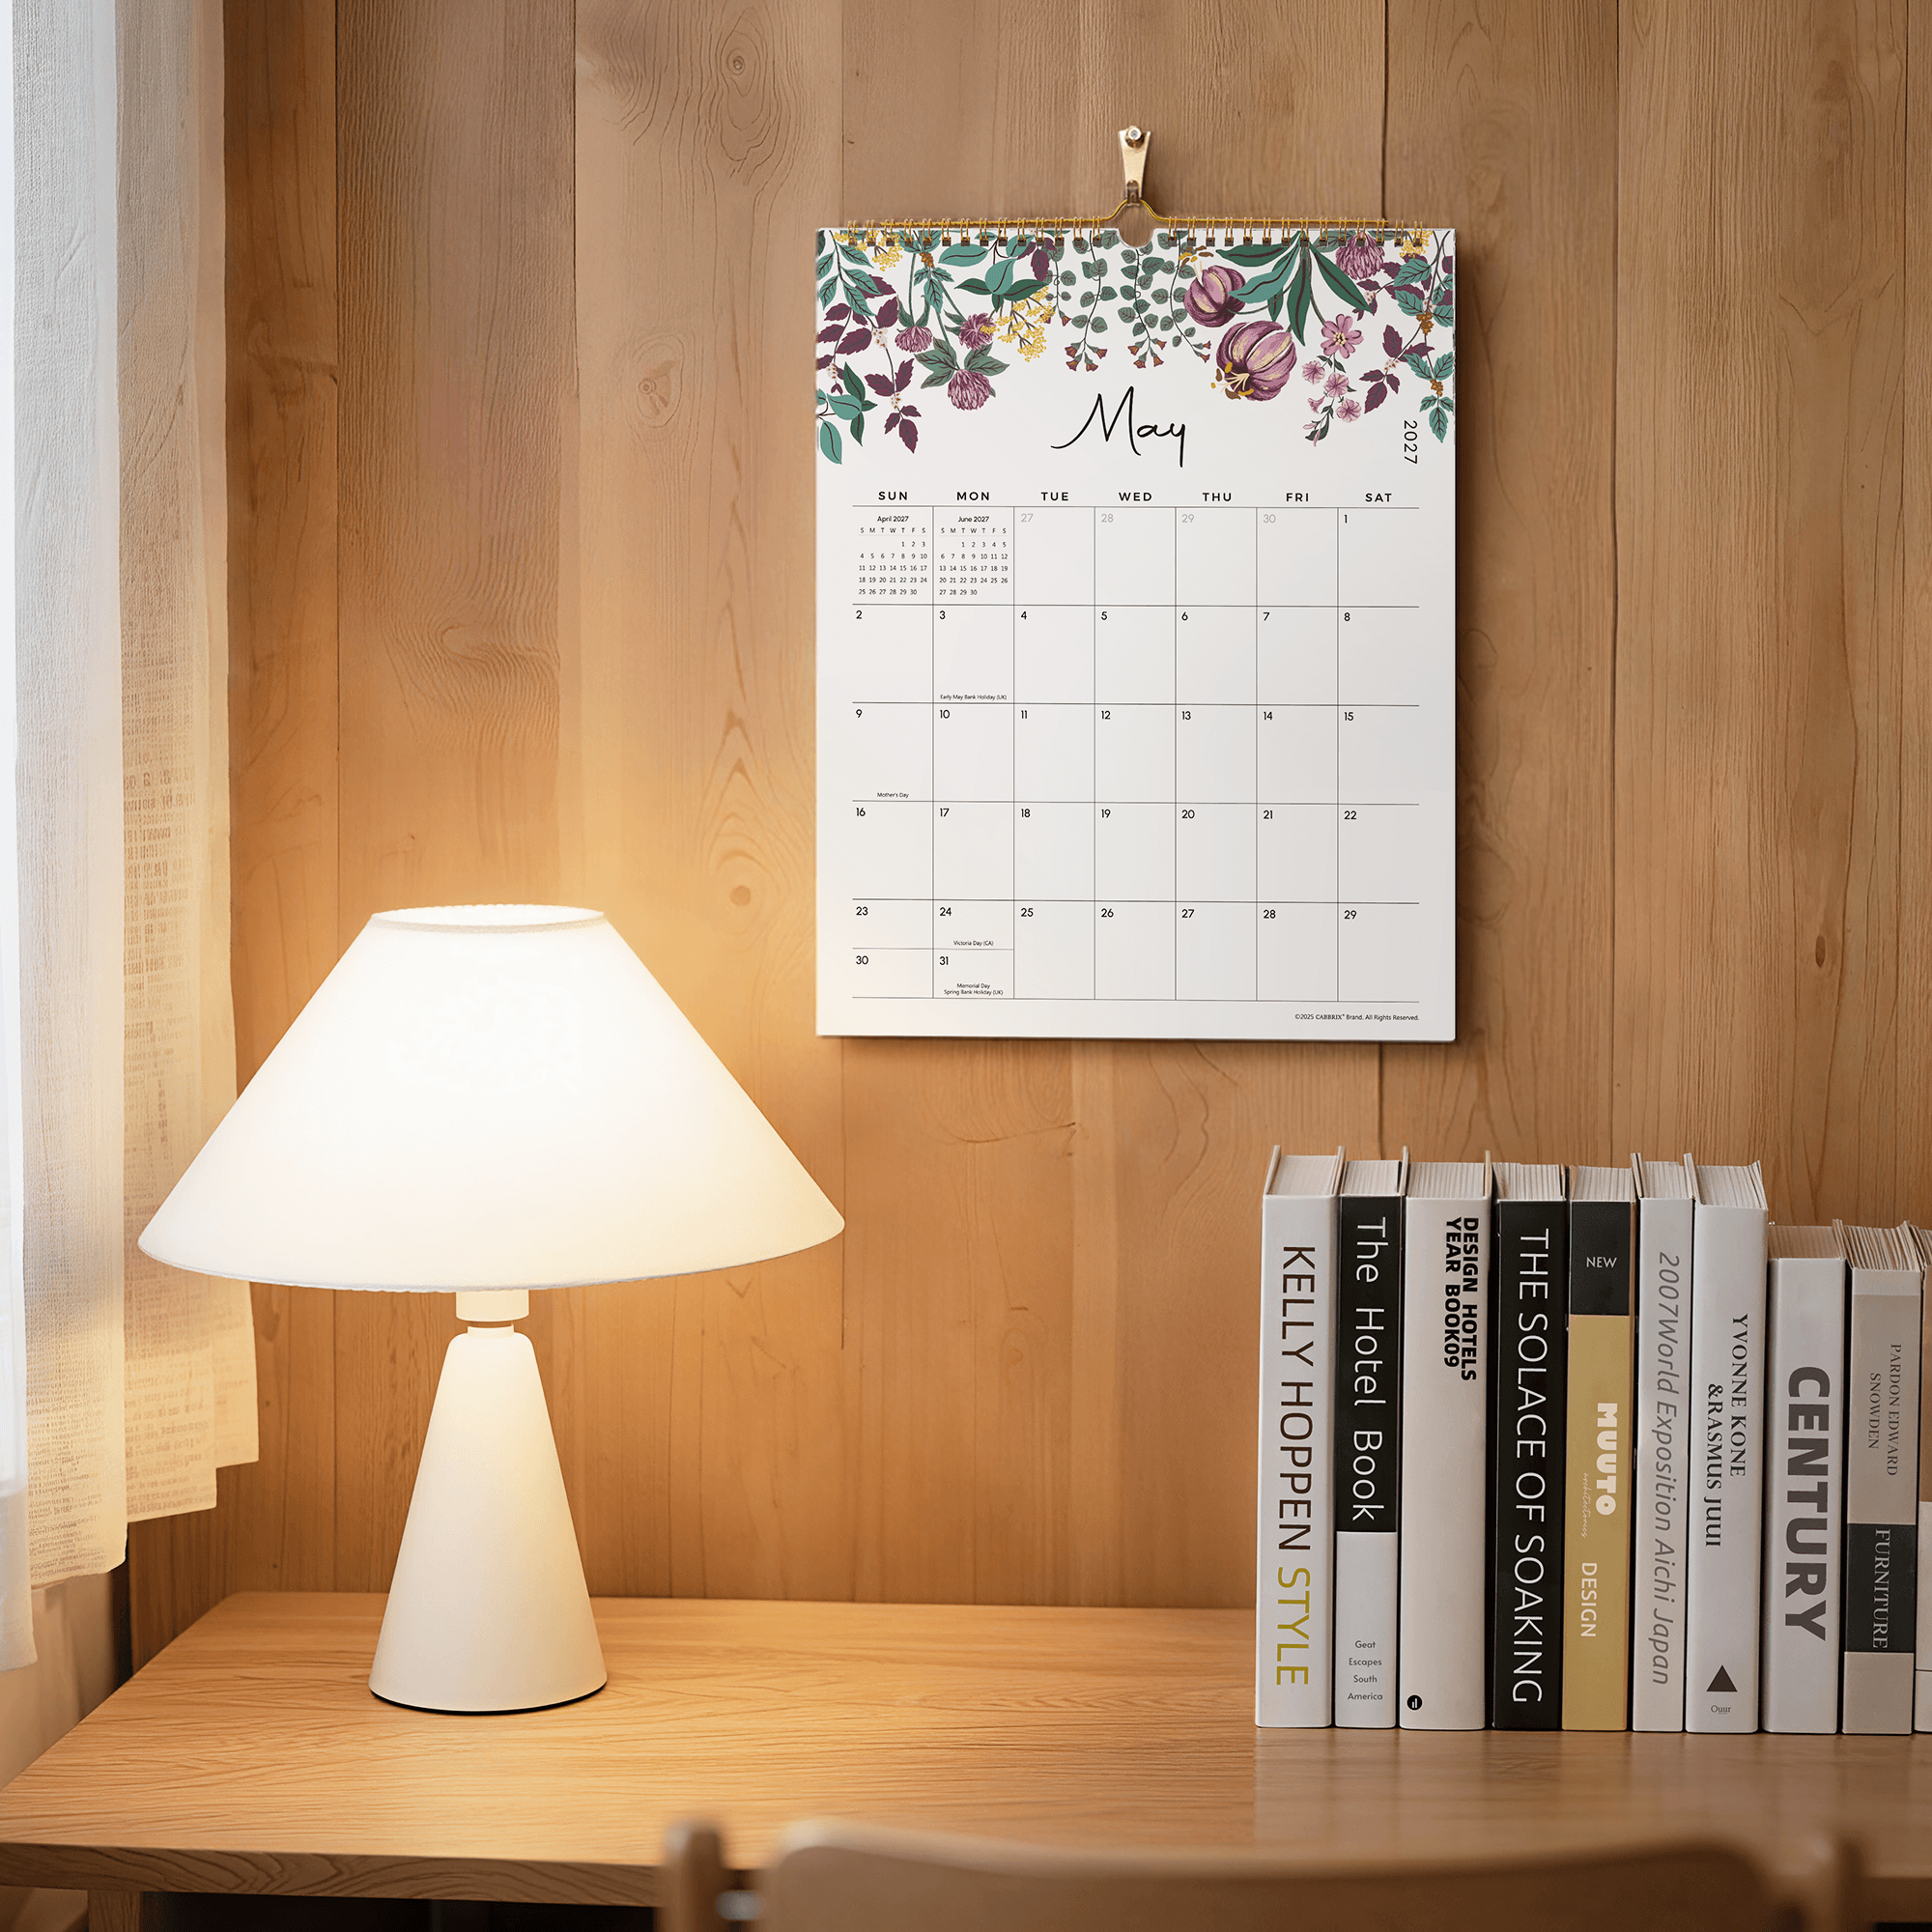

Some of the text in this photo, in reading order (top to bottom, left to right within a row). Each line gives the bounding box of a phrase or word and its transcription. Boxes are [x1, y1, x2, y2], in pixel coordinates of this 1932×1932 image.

[1050, 385, 1186, 469] May
[1404, 419, 1418, 465] 2027
[876, 515, 893, 524] April
[878, 491, 1392, 502] SUN MON TUE WED THU FRI SAT
[1020, 512, 1348, 524] 27 28 29 30 1
[856, 610, 1351, 622] 2 3 4 5 6 7 8
[855, 708, 1354, 722] 9 10 11 12 13 14 15
[856, 807, 1357, 820] 16 17 18 19 20 21 22
[856, 905, 1357, 920] 23 24 25 26 27 28 29
[855, 954, 949, 966] 30 31
[1443, 1216, 1462, 1368] YEAR BOOK09
[1461, 1217, 1479, 1381] DESIGN HOTELS
[1586, 1256, 1618, 1268] NEW
[1351, 1216, 1389, 1521] The Hotel Book
[1729, 1313, 1748, 1477] YVONNE KONE
[1706, 1383, 1724, 1490] &RASMUS
[1868, 1373, 1882, 1449] SNOWDEN
[1887, 1344, 1902, 1476] PARDON EDWARD
[1276, 1246, 1316, 1686] KELLY HOPPEN STYLE
[1512, 1228, 1549, 1702] THE SOLACE OF SOAKING
[1595, 1402, 1618, 1516] MUUTO
[1651, 1400, 1678, 1531] Exposition
[1784, 1366, 1831, 1642] CENTURY
[1580, 1562, 1598, 1637] DESIGN
[1654, 1538, 1677, 1604] Aichi
[1872, 1528, 1890, 1649] FURNITURE
[1349, 1657, 1382, 1668] Escapes
[1353, 1674, 1378, 1684] South
[1354, 1639, 1377, 1649] Geat
[1647, 1607, 1674, 1685] Japan
[1710, 1704, 1732, 1714] Ouur
